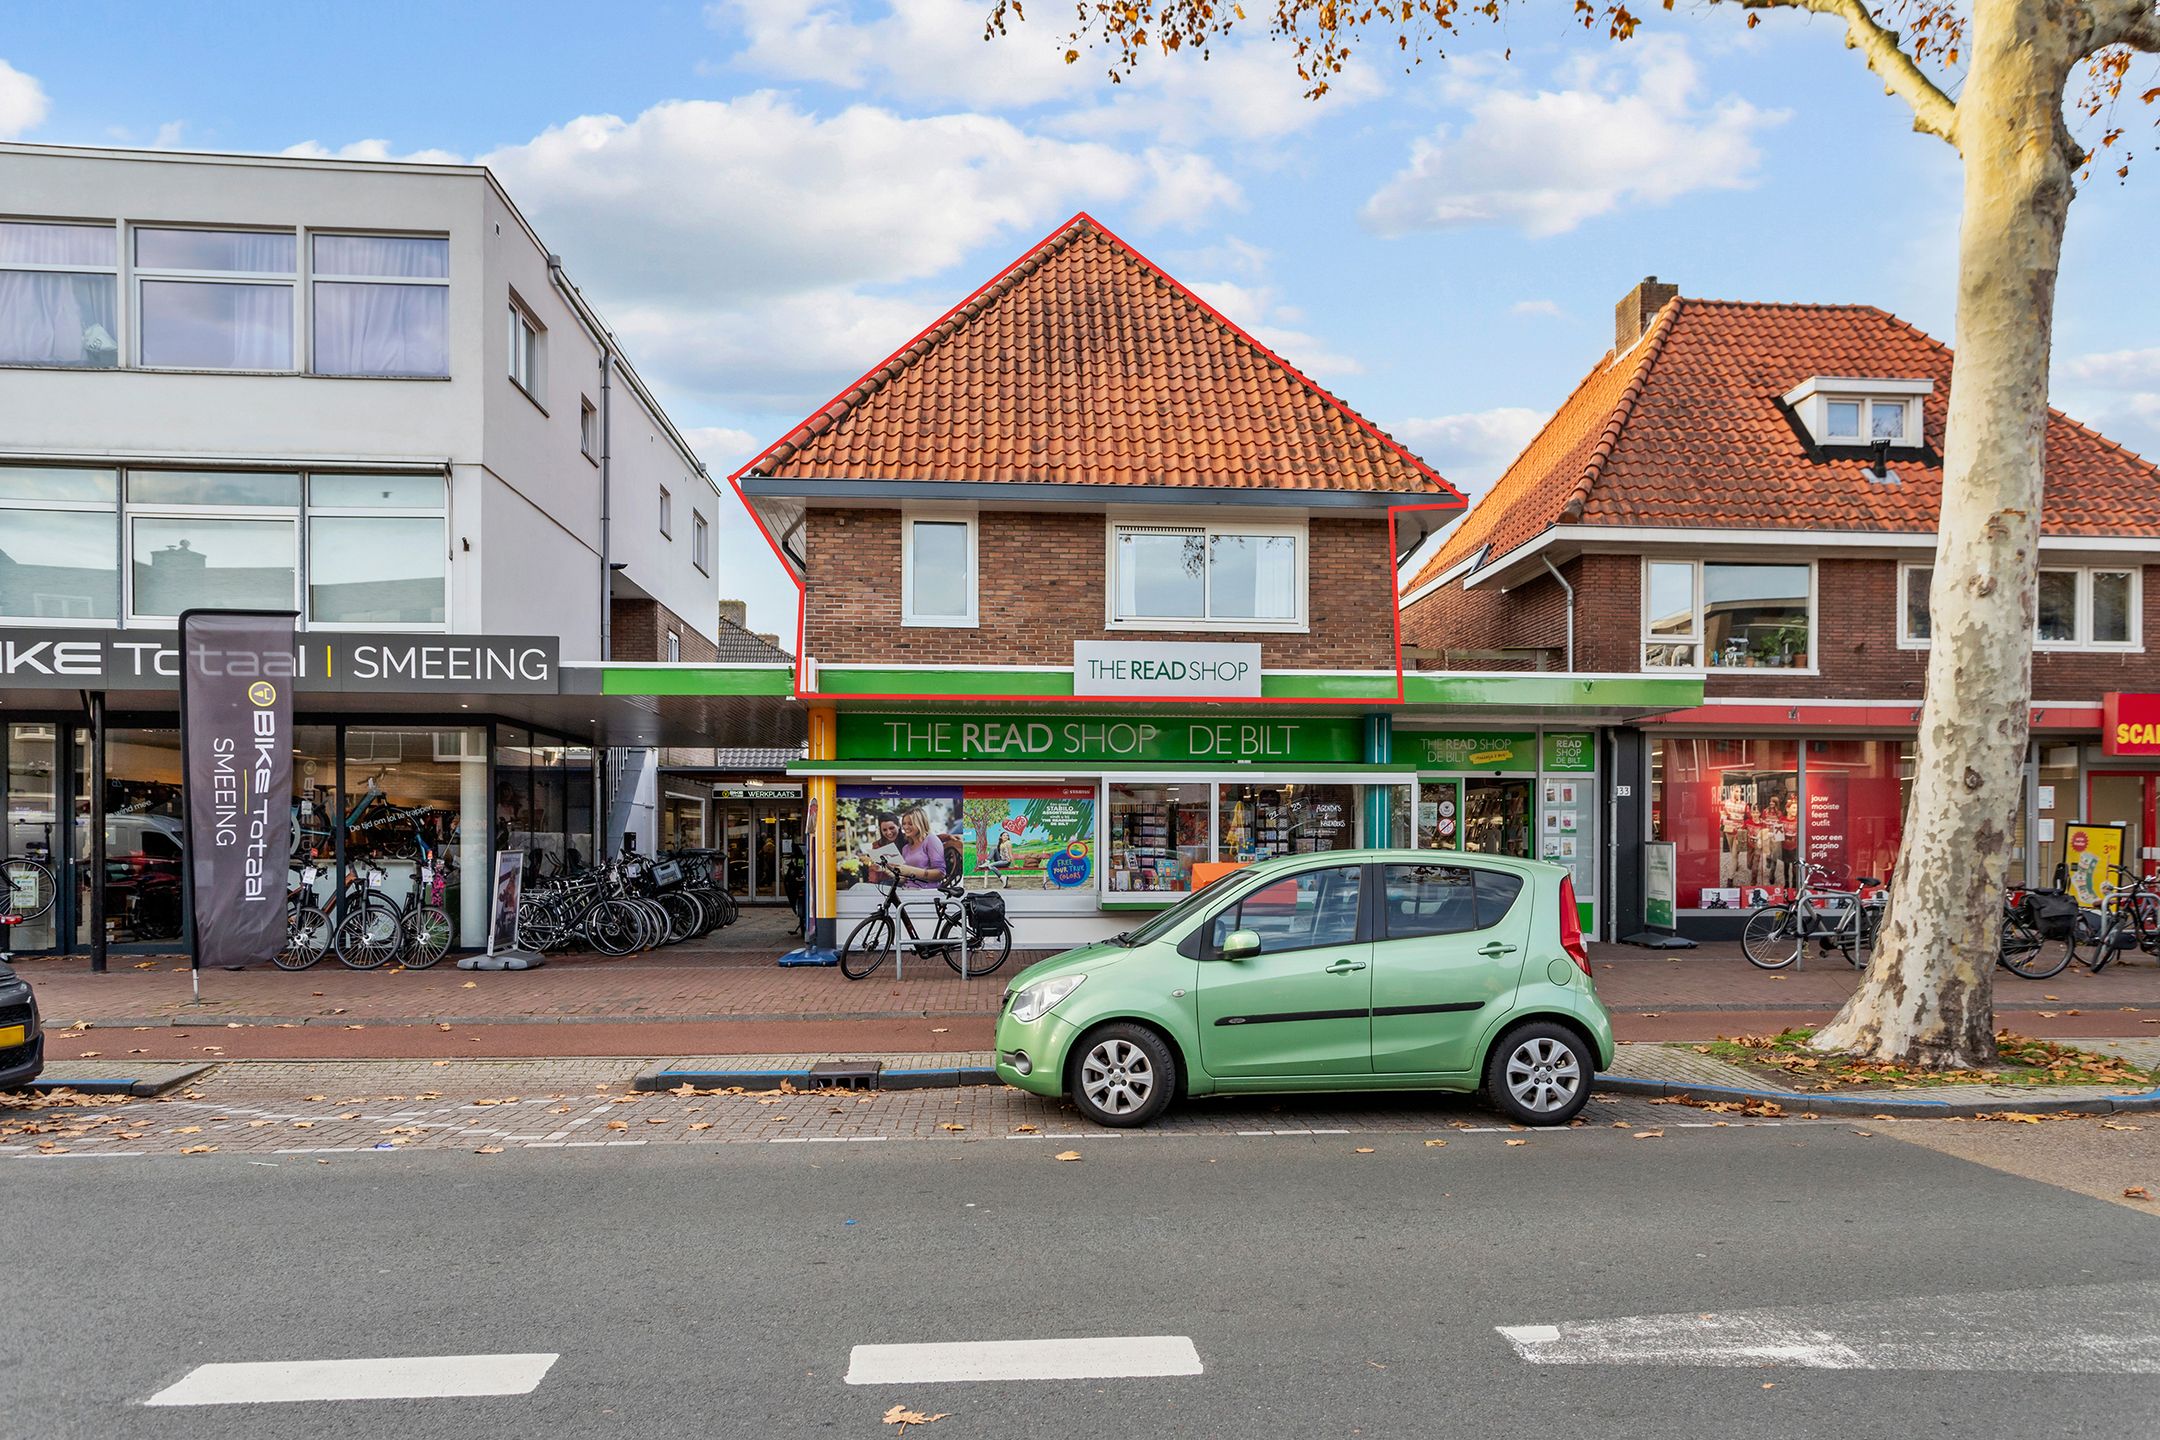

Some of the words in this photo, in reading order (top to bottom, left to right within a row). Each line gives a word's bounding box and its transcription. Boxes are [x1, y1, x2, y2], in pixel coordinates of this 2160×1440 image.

[353, 645, 548, 680] SMEEING
[1087, 659, 1126, 679] THE
[884, 722, 952, 752] THE
[962, 723, 1054, 753] READ
[1064, 723, 1157, 753] SHOP
[1189, 725, 1233, 755] DE
[1241, 725, 1300, 755] BILT
[1421, 739, 1443, 750] THE
[1446, 739, 1477, 750] READ
[1480, 738, 1512, 750] SHOP
[1556, 740, 1581, 748] READ
[253, 710, 276, 794] BIKE
[1428, 751, 1442, 762] DE
[1445, 751, 1467, 762] BILT
[1556, 749, 1582, 757] SHOP
[213, 738, 237, 846] SMEEING
[748, 790, 795, 798] WERKPLAATS
[1811, 794, 1828, 803] jouw
[1811, 819, 1830, 827] outfit
[245, 799, 268, 901] Totaal
[1811, 843, 1839, 851] scapino
[1811, 851, 1827, 859] prijs
[1057, 859, 1073, 867] FREE
